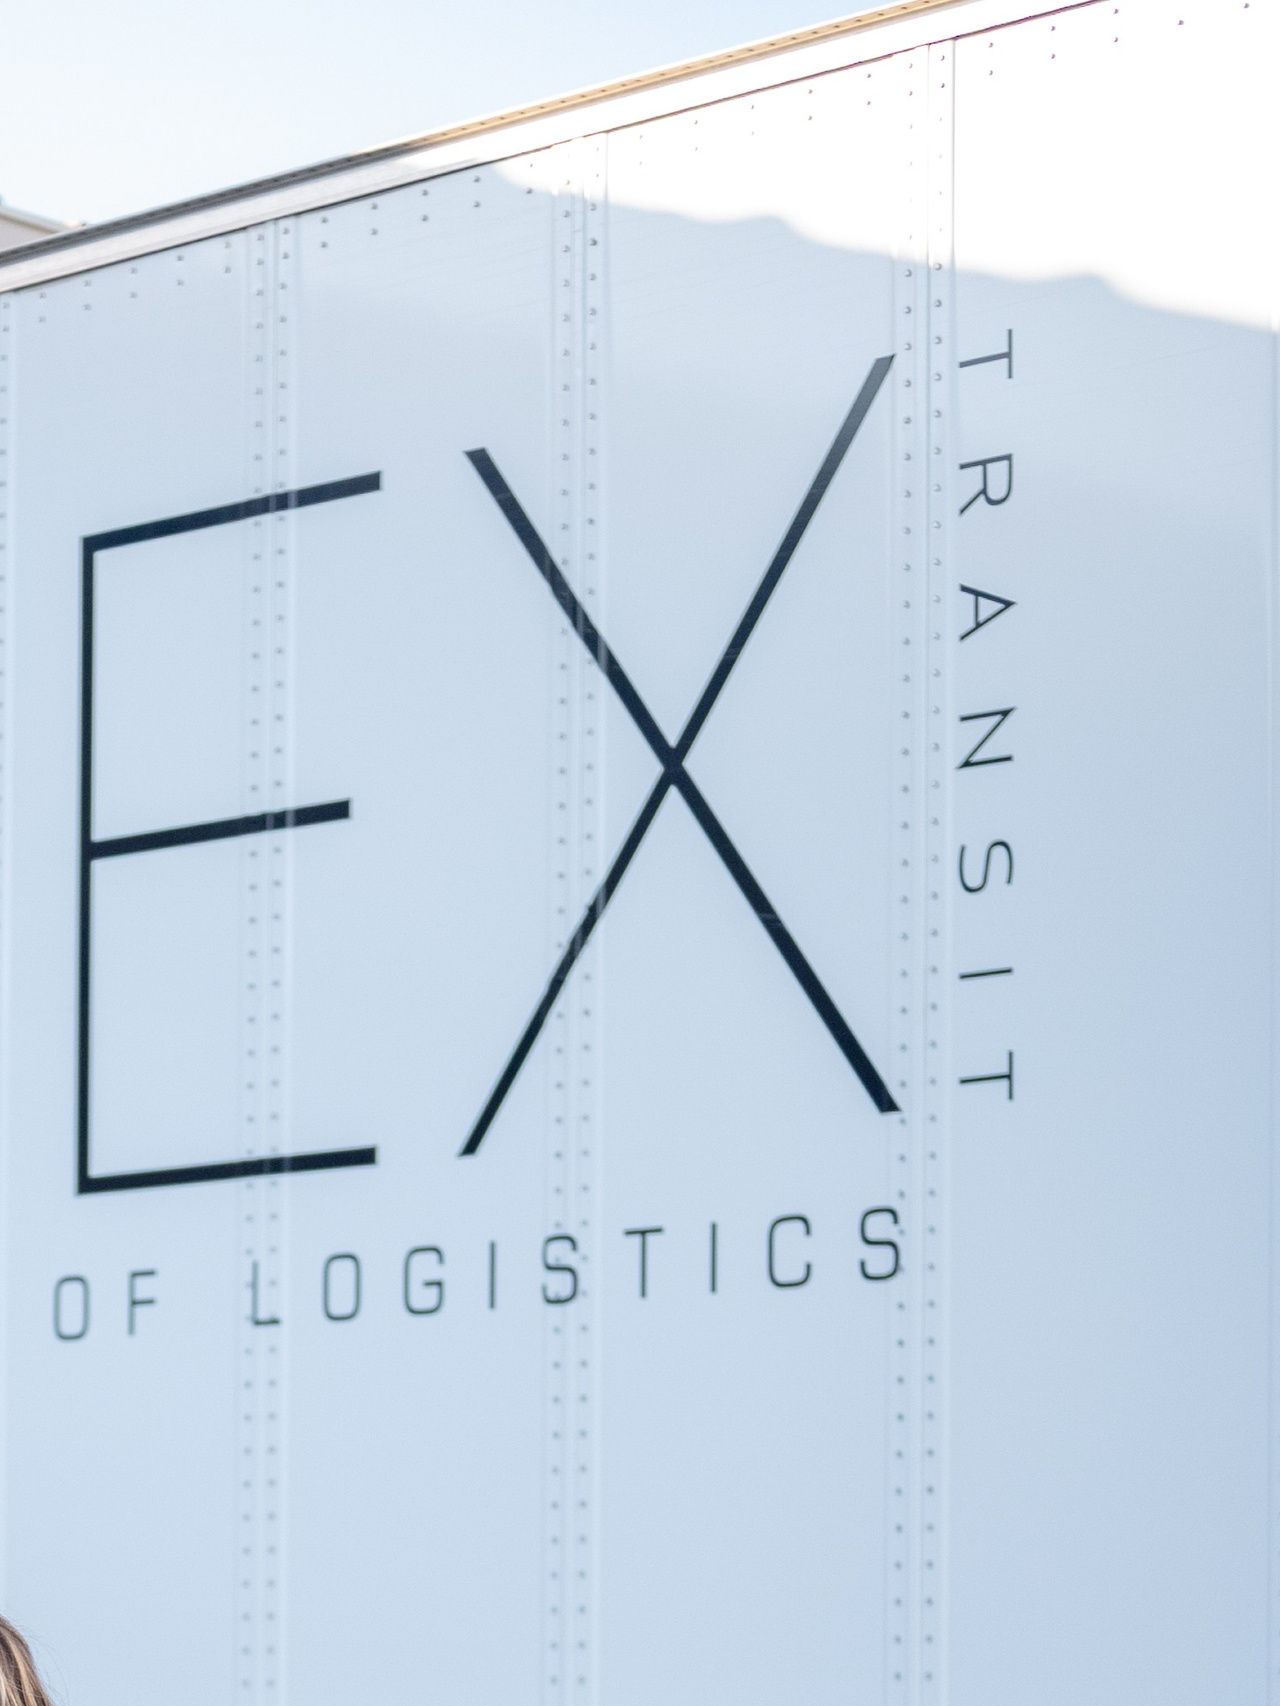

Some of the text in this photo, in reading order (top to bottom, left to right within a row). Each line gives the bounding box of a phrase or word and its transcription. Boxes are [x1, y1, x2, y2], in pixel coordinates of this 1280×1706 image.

[958, 328, 1017, 1101] TRANSIT
[53, 1270, 158, 1341] OF
[247, 1207, 902, 1327] LOGISTICS
